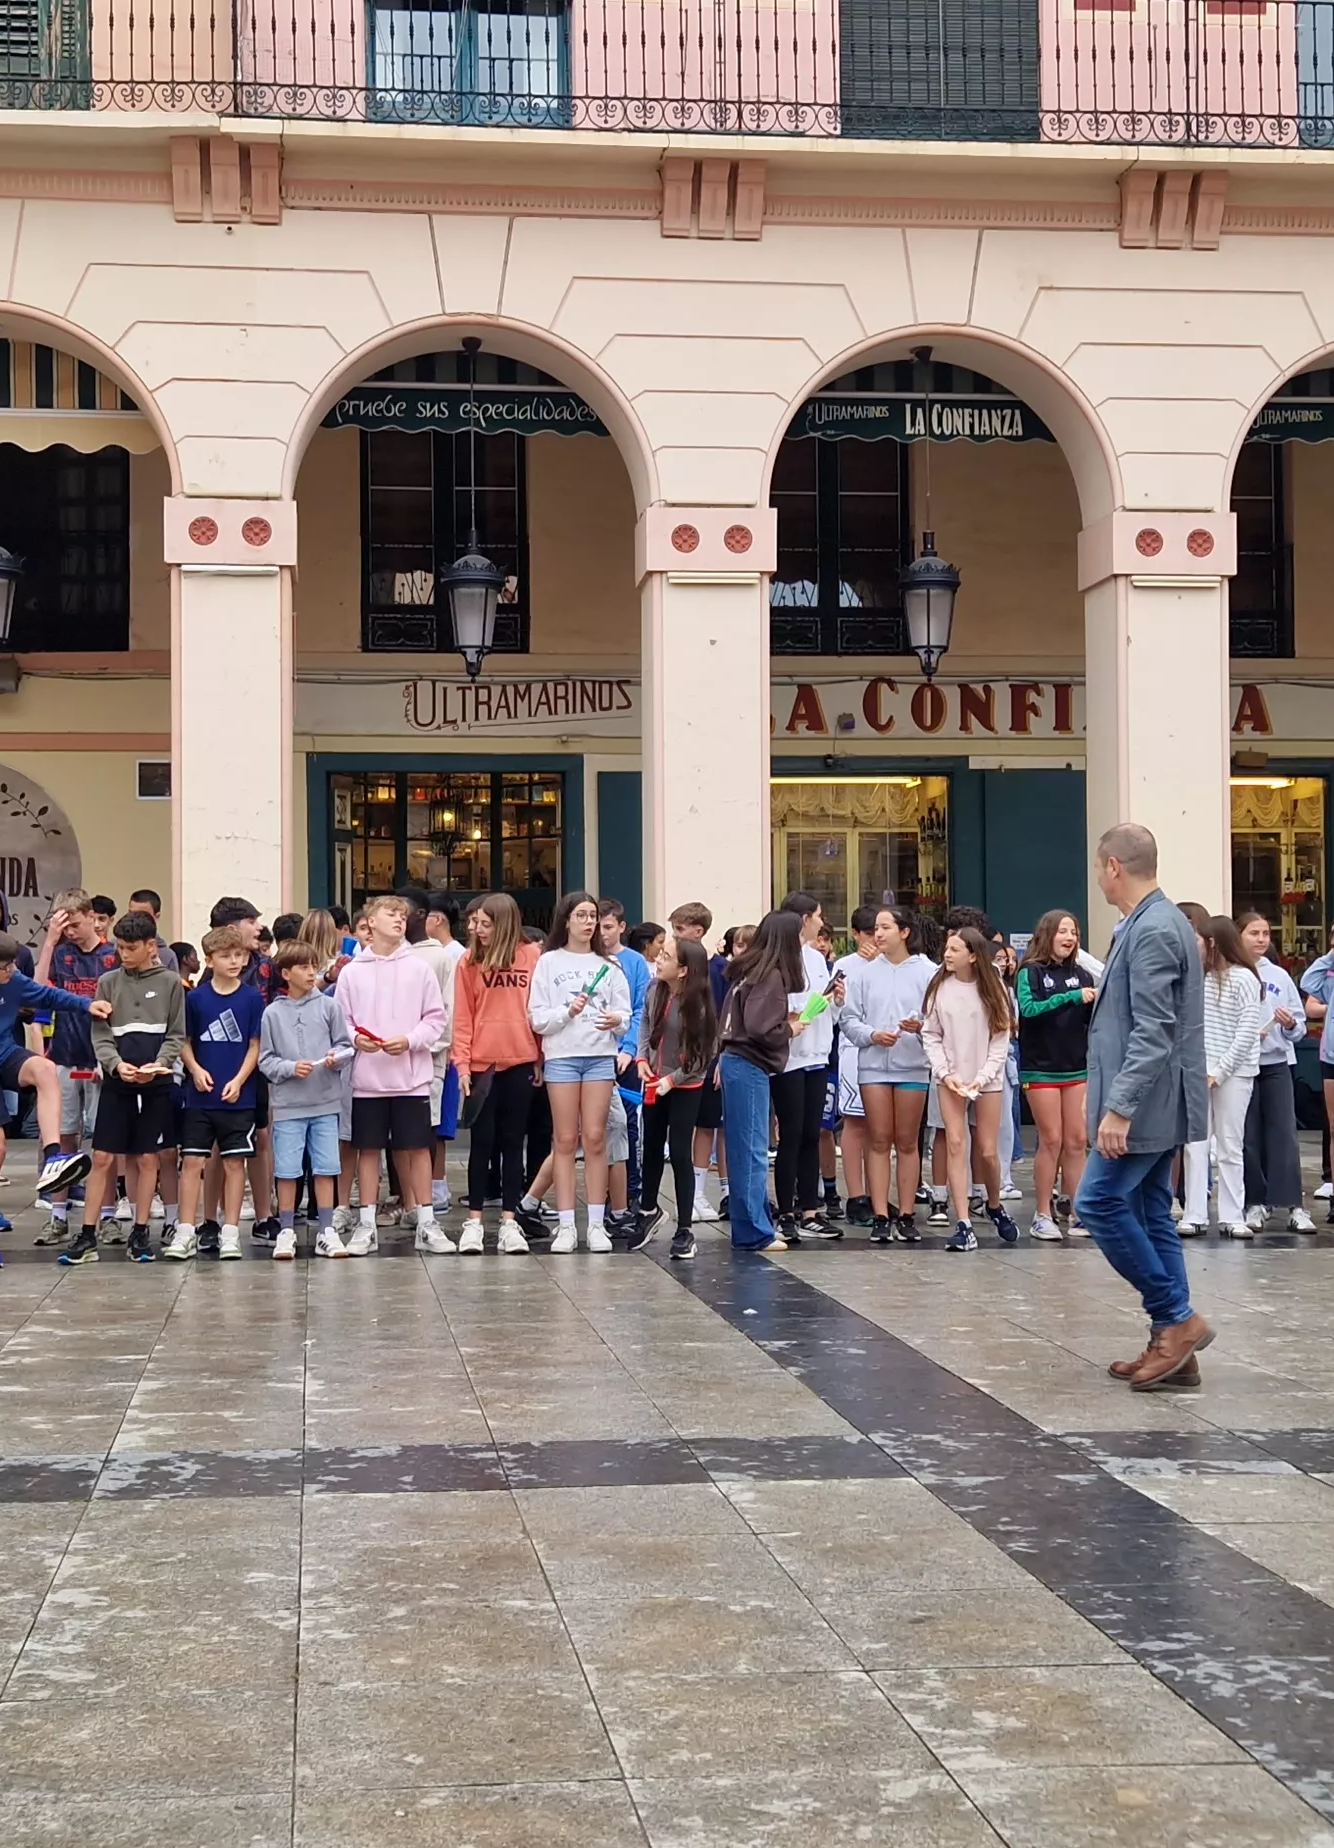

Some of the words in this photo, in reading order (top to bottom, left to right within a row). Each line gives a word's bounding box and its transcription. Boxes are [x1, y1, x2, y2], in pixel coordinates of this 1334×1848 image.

[335, 395, 407, 423] pruebe
[415, 402, 449, 418] sus
[459, 398, 597, 427] especialidades
[815, 403, 889, 424] ULTRAMARINOS
[905, 403, 925, 435] LA
[931, 404, 1023, 436] CONFIANZA
[411, 680, 633, 729] ULTRAMARINOS
[482, 972, 529, 989] VANS
